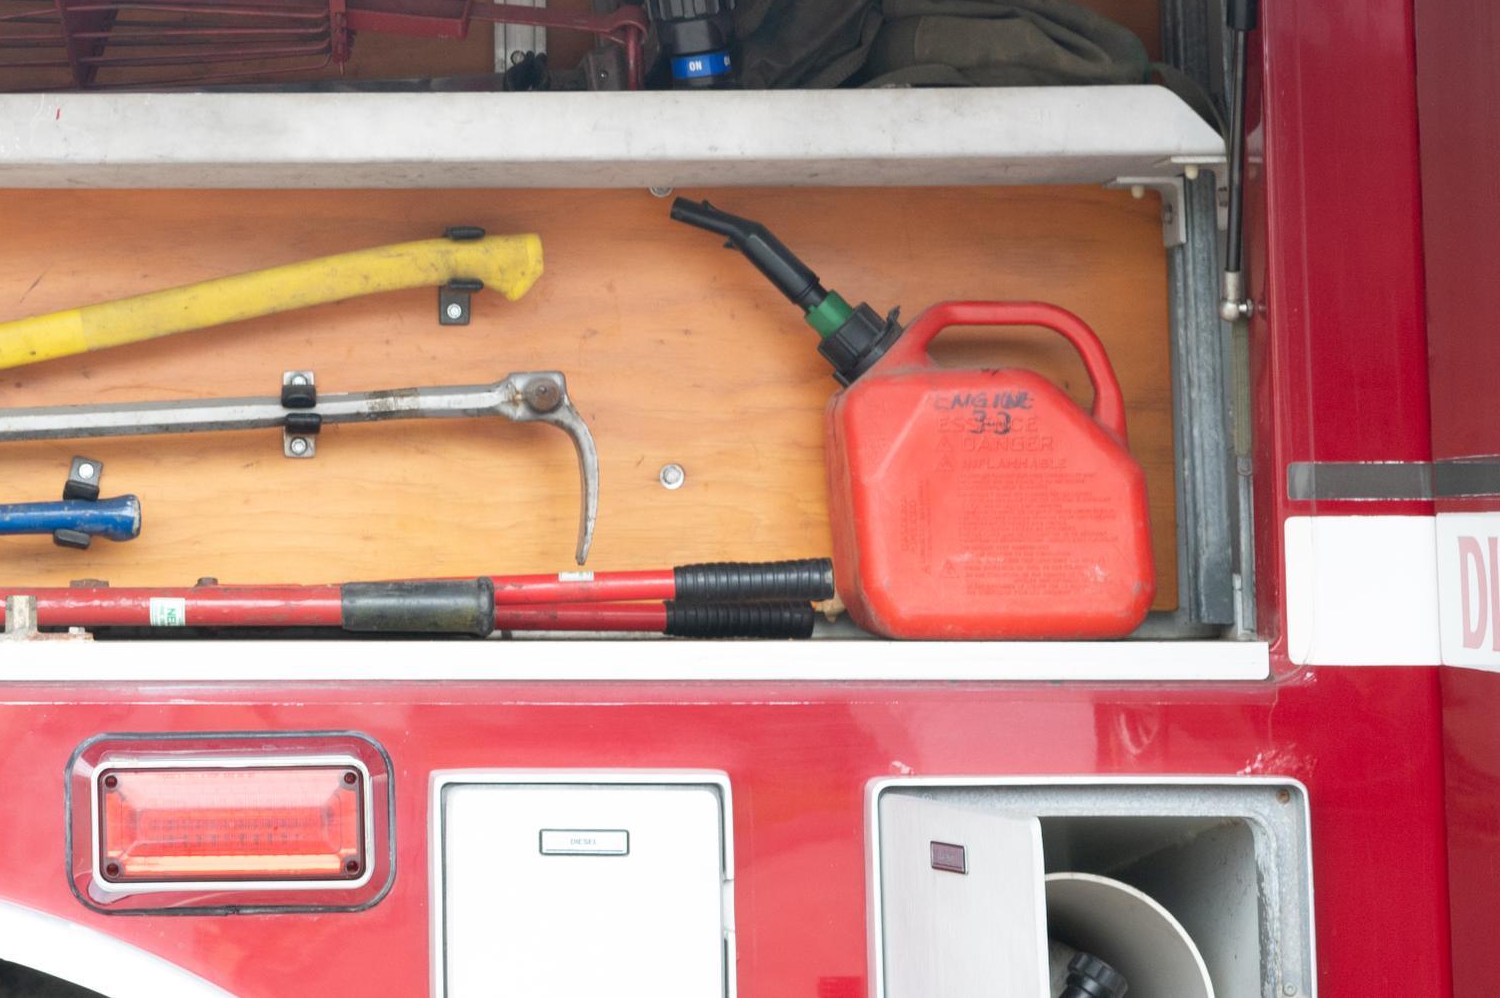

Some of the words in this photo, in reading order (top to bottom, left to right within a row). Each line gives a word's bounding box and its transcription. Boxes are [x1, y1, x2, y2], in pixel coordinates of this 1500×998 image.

[688, 60, 703, 72] ON
[937, 416, 1039, 433] ESSCE
[960, 436, 1054, 452] DANGER
